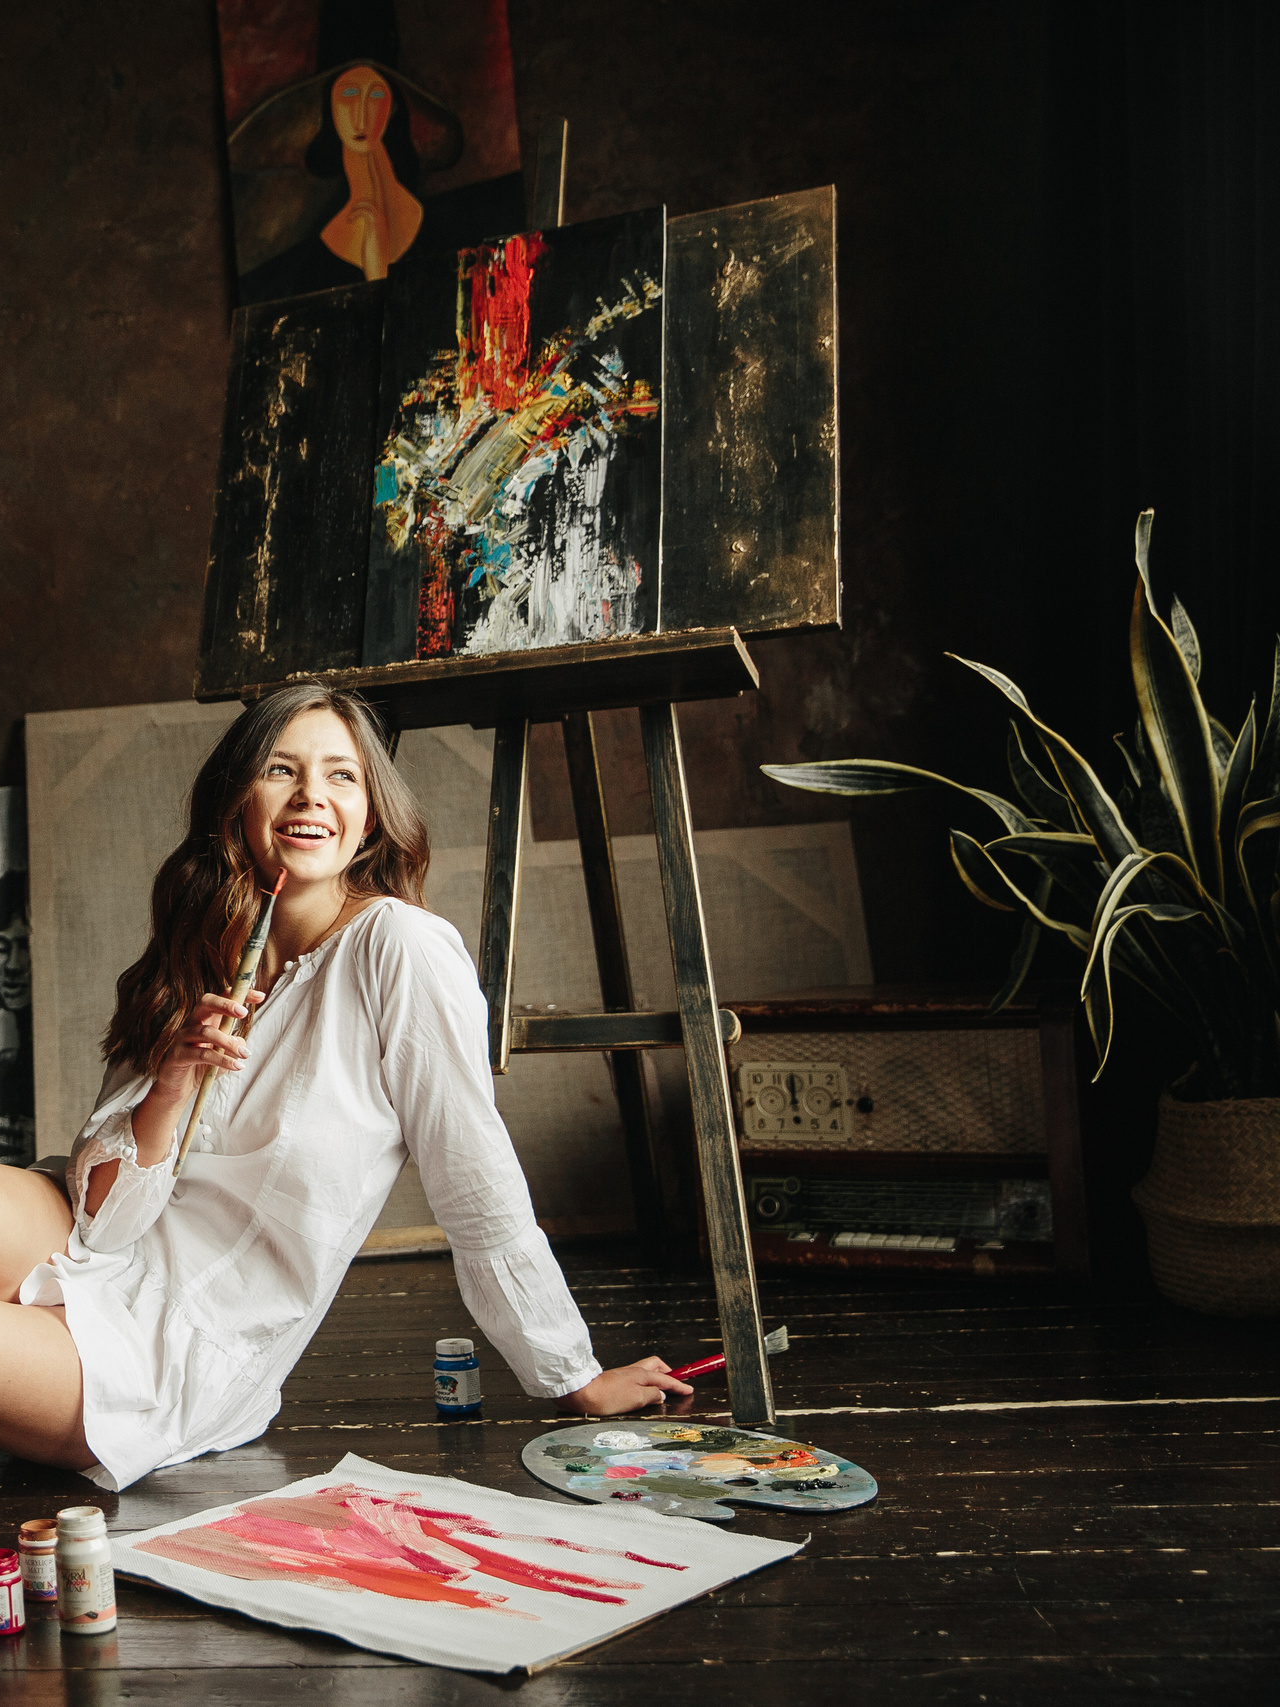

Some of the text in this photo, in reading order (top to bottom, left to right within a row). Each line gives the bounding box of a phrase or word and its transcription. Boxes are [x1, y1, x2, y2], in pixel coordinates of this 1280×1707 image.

[752, 1073, 763, 1084] 10
[772, 1073, 781, 1084] 11
[825, 1073, 834, 1085] 2
[757, 1118, 838, 1130] 8 7 5 4
[27, 1566, 44, 1574] MATT
